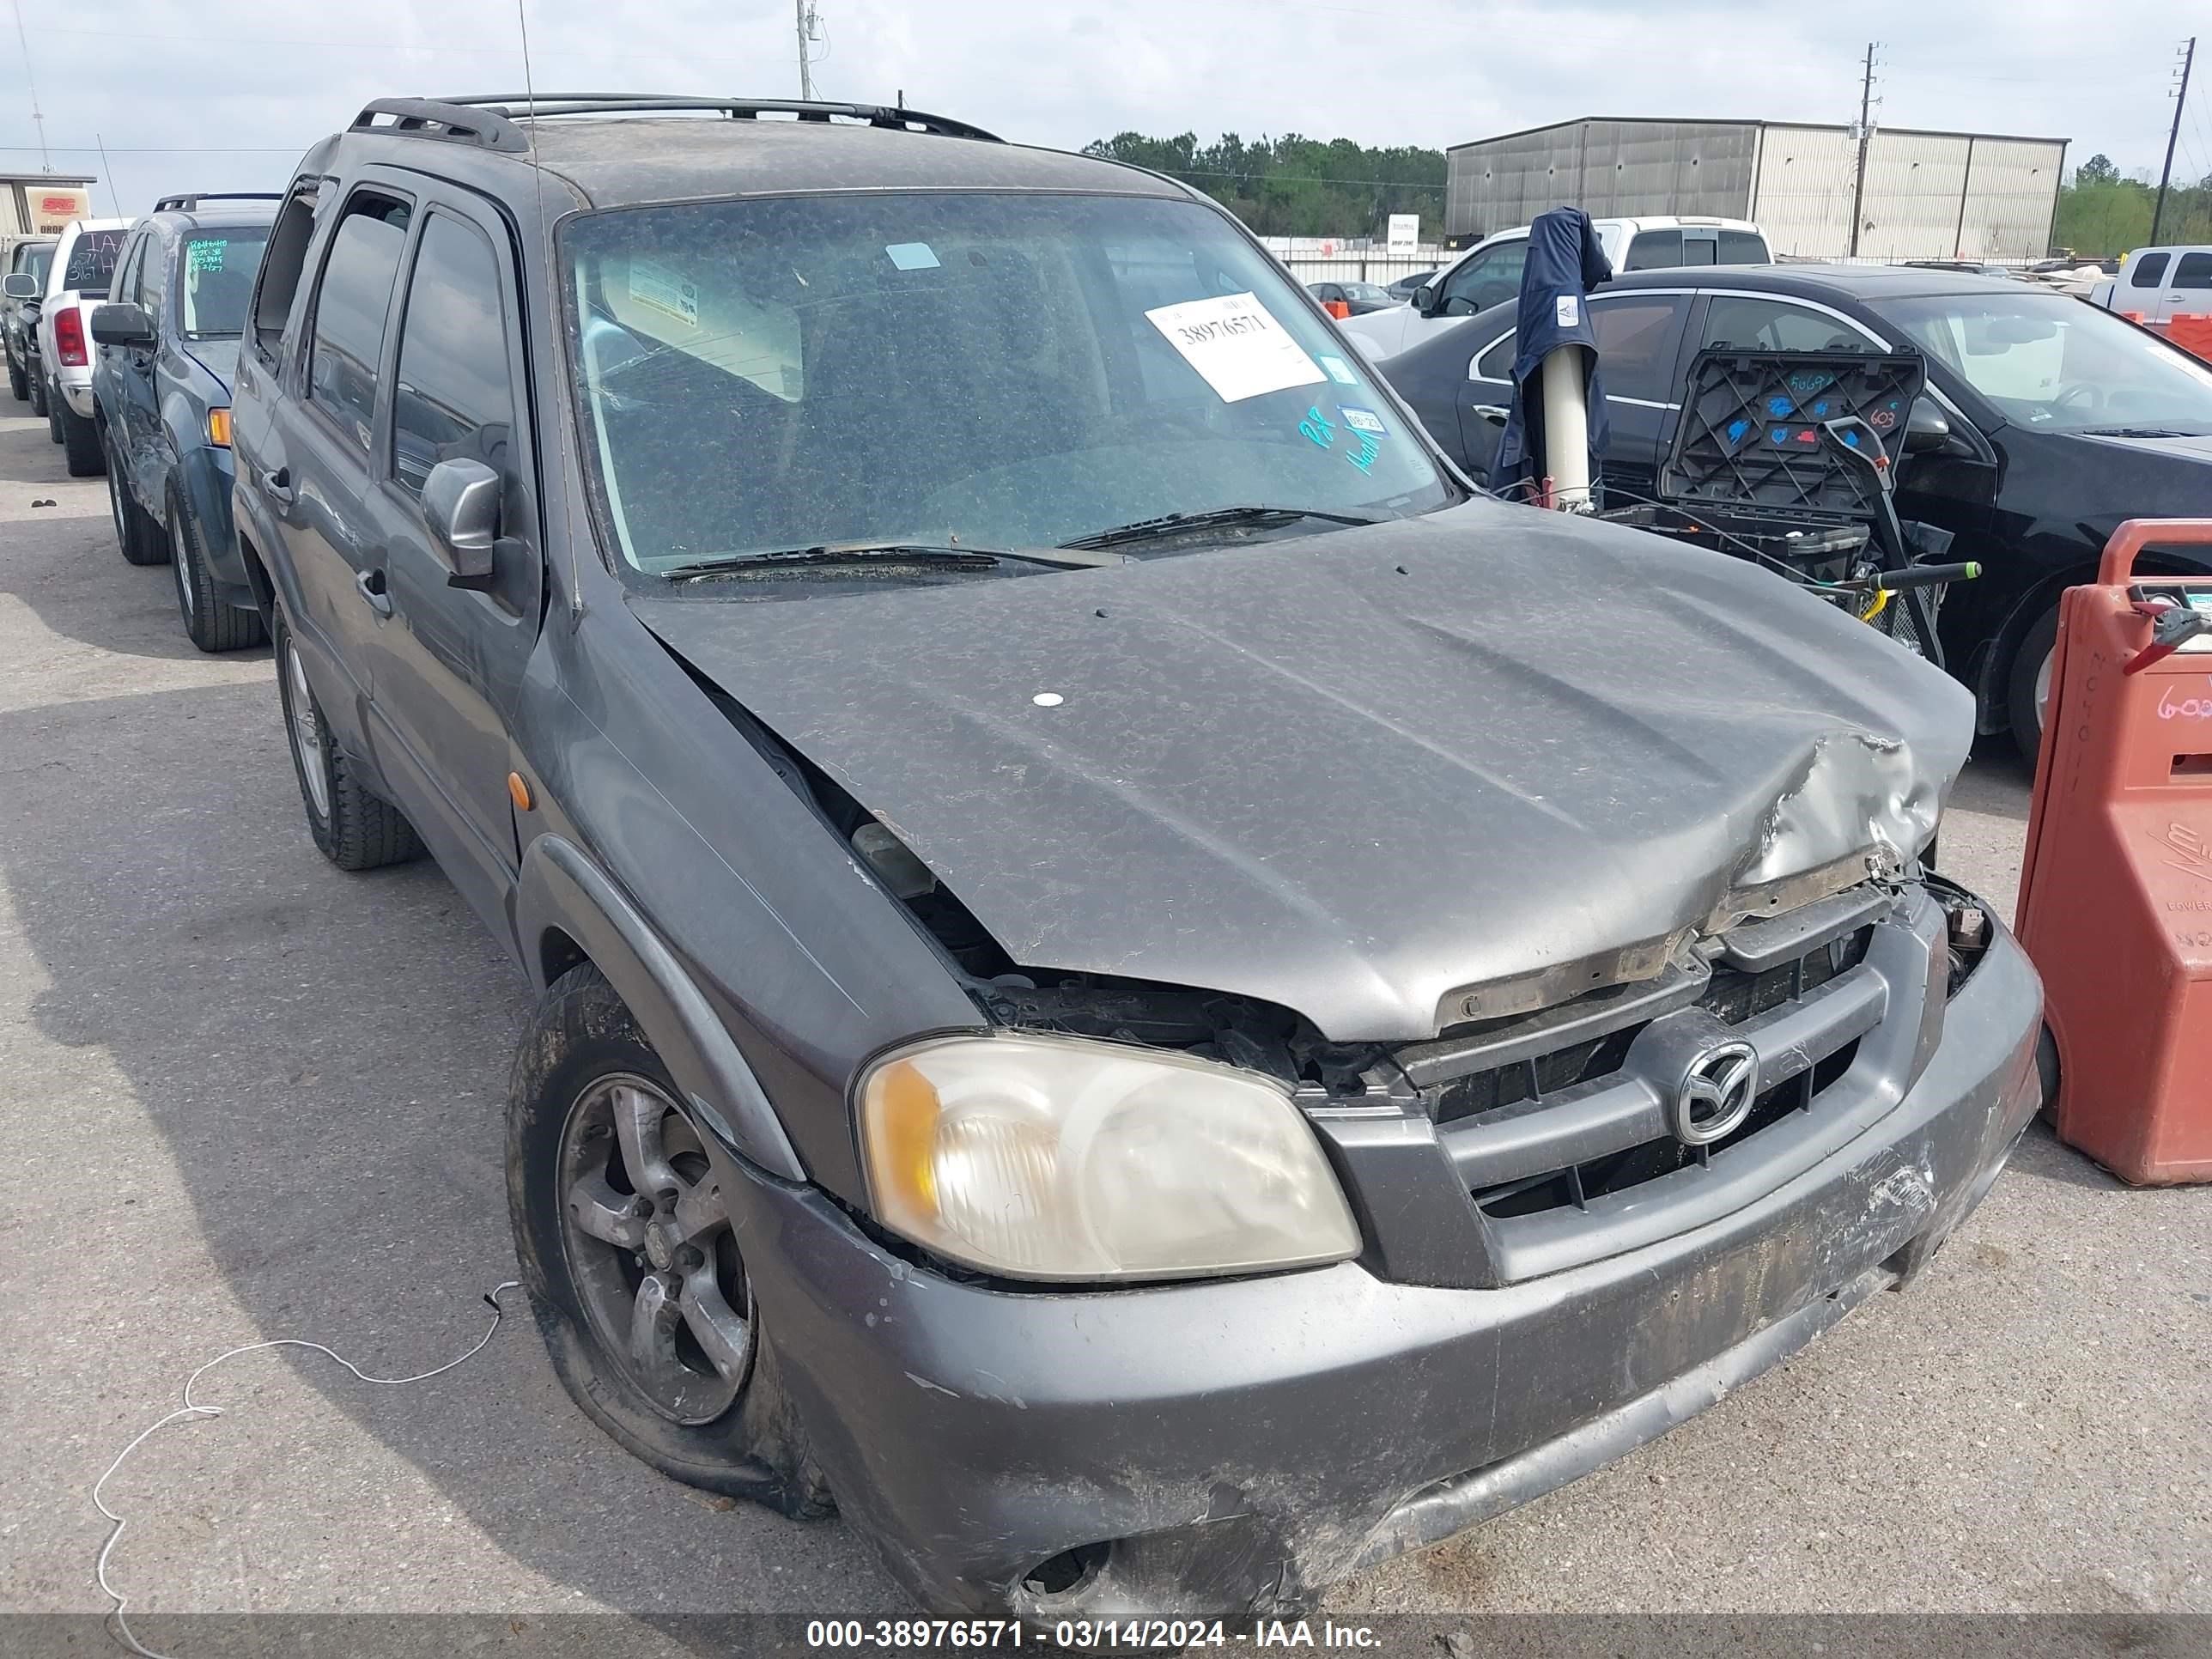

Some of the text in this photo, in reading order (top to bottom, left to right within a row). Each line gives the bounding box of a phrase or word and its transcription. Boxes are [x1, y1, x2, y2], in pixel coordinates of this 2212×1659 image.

[40, 225, 64, 234] DROP
[1178, 314, 1267, 345] 38976571
[1870, 408, 1896, 428] 603
